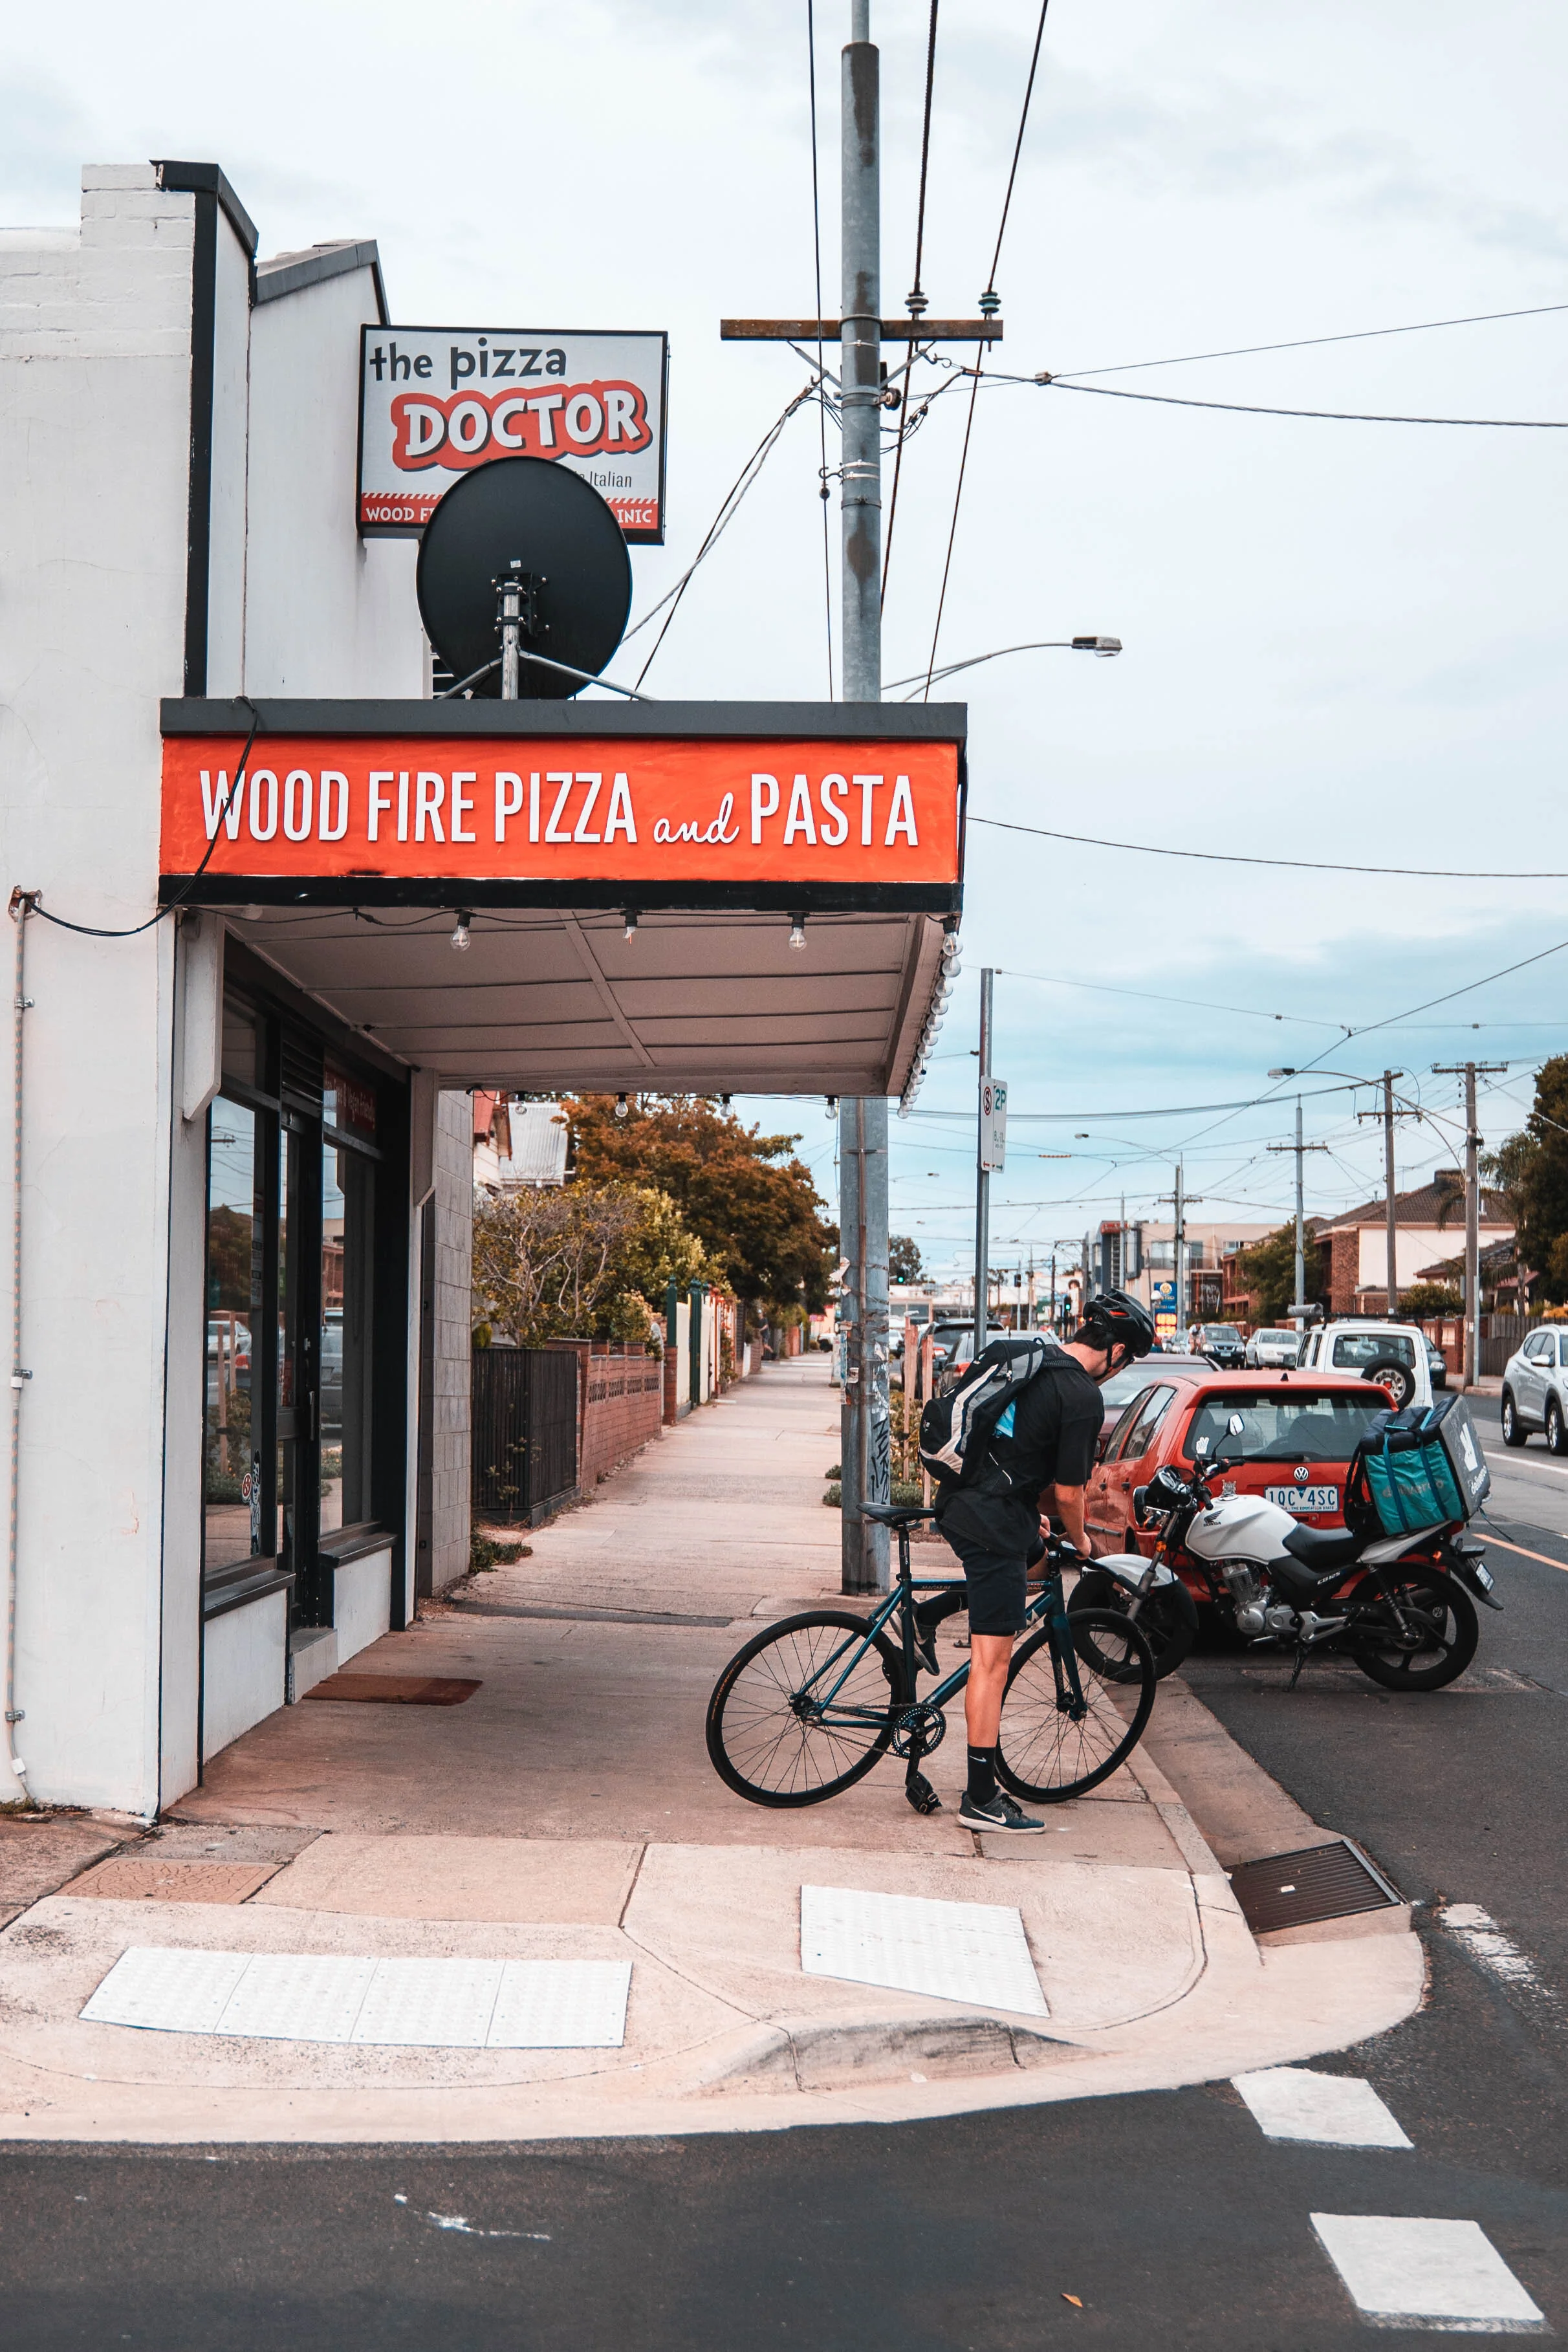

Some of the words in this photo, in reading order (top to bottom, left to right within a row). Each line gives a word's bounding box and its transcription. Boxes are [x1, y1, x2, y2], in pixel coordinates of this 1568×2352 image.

[369, 342, 433, 381] the
[450, 337, 567, 390] pizza
[403, 389, 644, 457] DOCTOR
[589, 471, 632, 488] Italian
[365, 506, 415, 521] WOOD
[199, 769, 349, 842] WOOD
[367, 771, 477, 843] FIRE
[495, 772, 638, 844] PIZZA
[653, 792, 740, 844] and
[750, 773, 919, 846] PASTA
[994, 1088, 1007, 1111] 2P
[1307, 1490, 1335, 1505] 4SC
